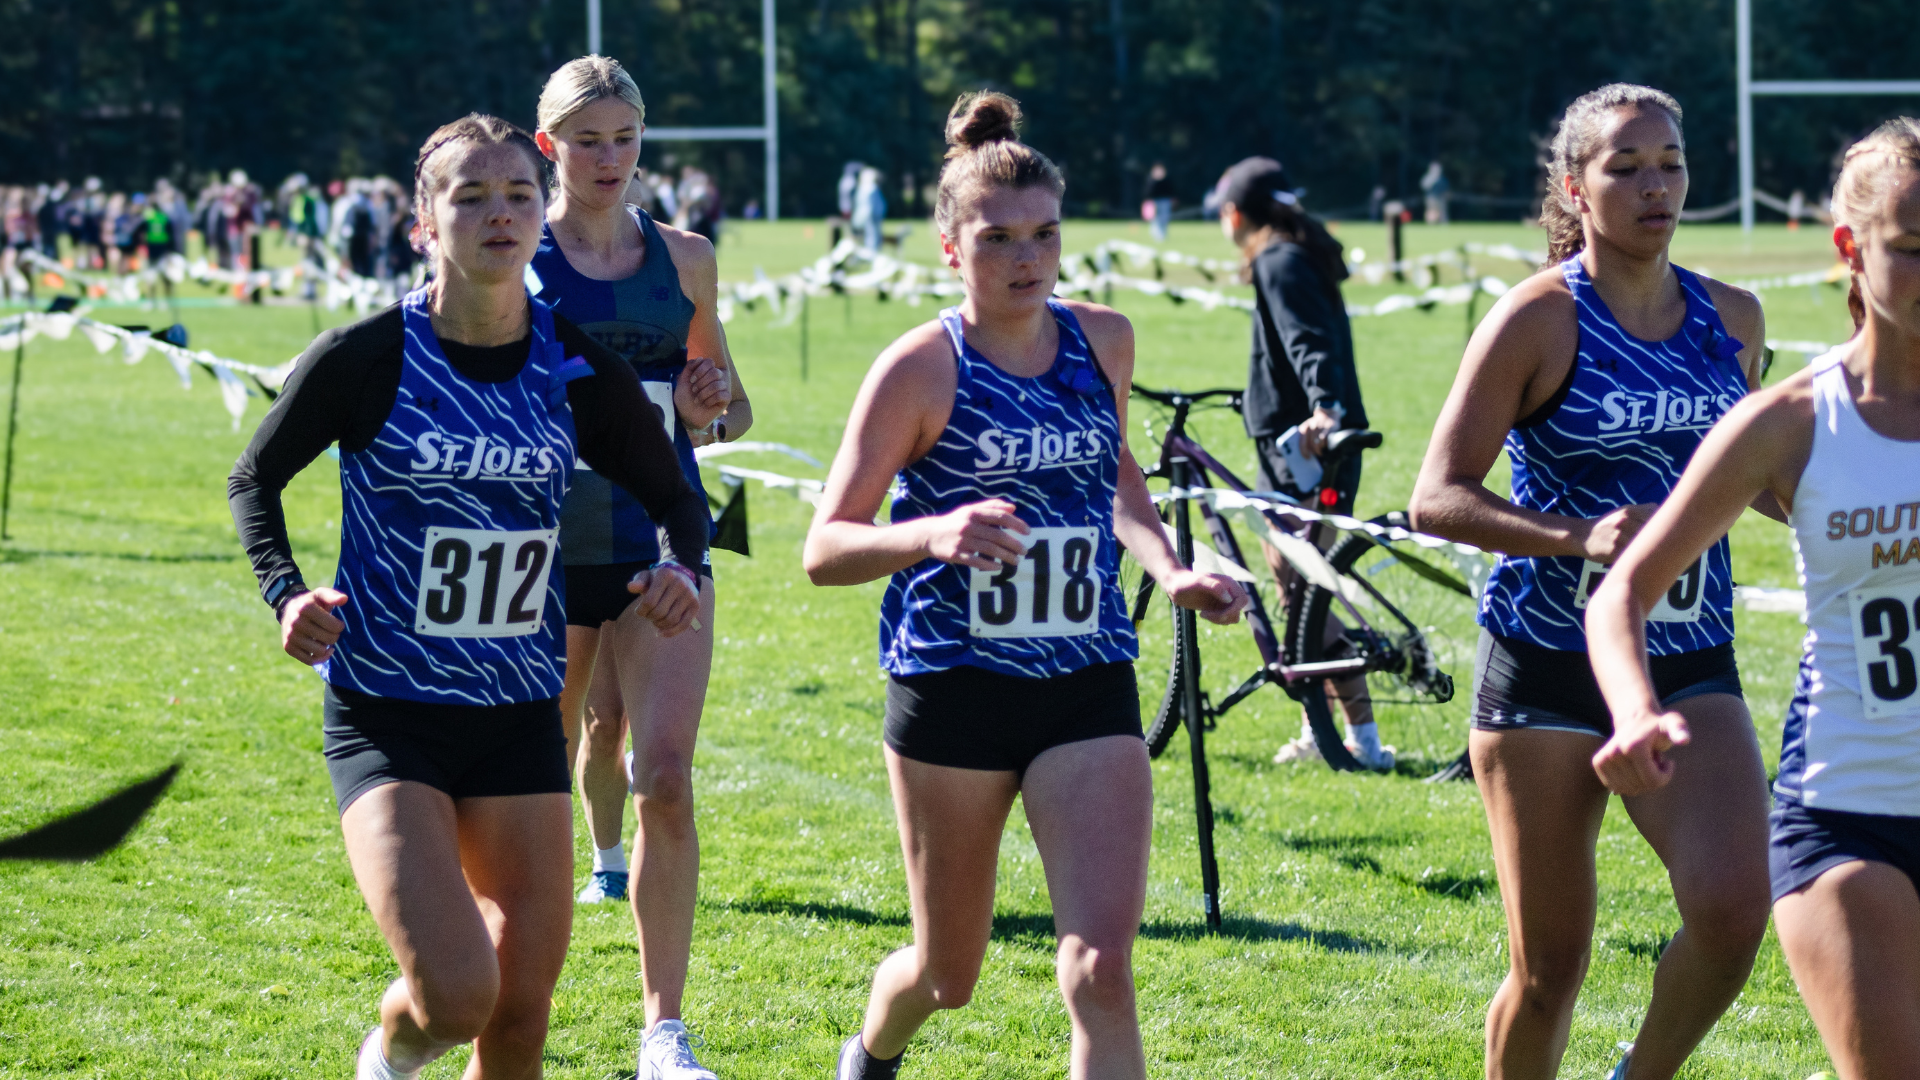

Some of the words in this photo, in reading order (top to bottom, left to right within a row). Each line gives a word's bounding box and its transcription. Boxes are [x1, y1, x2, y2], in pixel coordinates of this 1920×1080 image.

[425, 537, 549, 626] 312
[978, 536, 1095, 626] 318
[1860, 595, 1920, 703] 3
